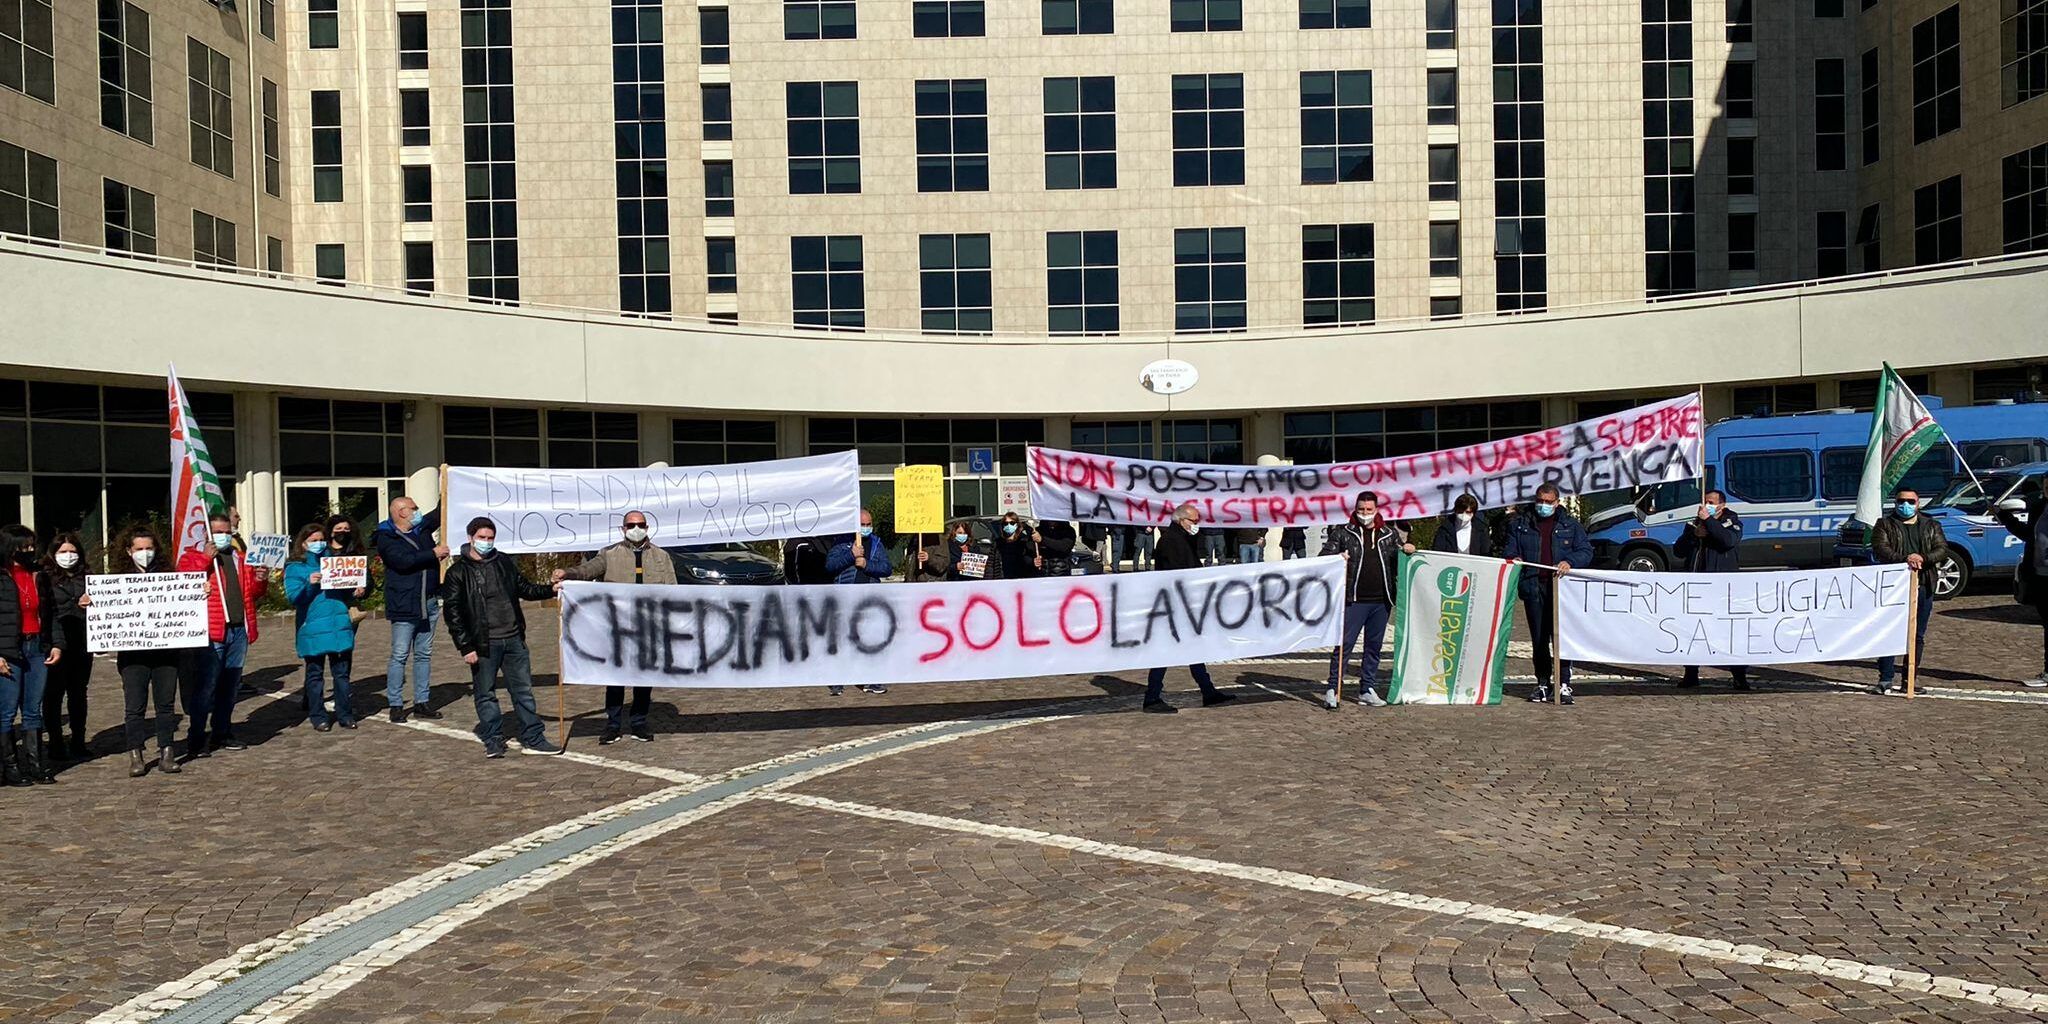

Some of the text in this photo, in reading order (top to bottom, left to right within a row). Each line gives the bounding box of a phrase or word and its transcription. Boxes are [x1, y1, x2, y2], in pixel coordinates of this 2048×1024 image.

[1035, 405, 1701, 494] NON POSSIAMO CONTINUARE A SUBIRE
[1071, 492, 1116, 520] LA
[1436, 443, 1694, 513] INTERVENGA
[485, 468, 769, 510] DIFENDIAMO IL
[677, 498, 821, 540] LAVORO
[1758, 517, 1850, 533] POLIZ
[322, 557, 366, 570] SIAMO
[125, 575, 156, 584] TERMALI
[159, 574, 180, 582] DELLE
[183, 572, 206, 580] TERME
[128, 586, 149, 595] SONO
[166, 583, 190, 592] BENE
[1569, 568, 1906, 615] TERME LUIGIANE
[147, 594, 167, 604] TUTTI
[88, 612, 101, 622] CHE
[147, 611, 162, 620] NEL
[97, 623, 113, 631] NON
[154, 620, 188, 629] SINDACI
[563, 573, 1331, 674] CHIEDIAMO SOLO LAVORO
[91, 631, 137, 642] AUTORITARI
[139, 630, 160, 639] NELLA
[162, 629, 185, 639] LORO
[100, 641, 110, 649] DI
